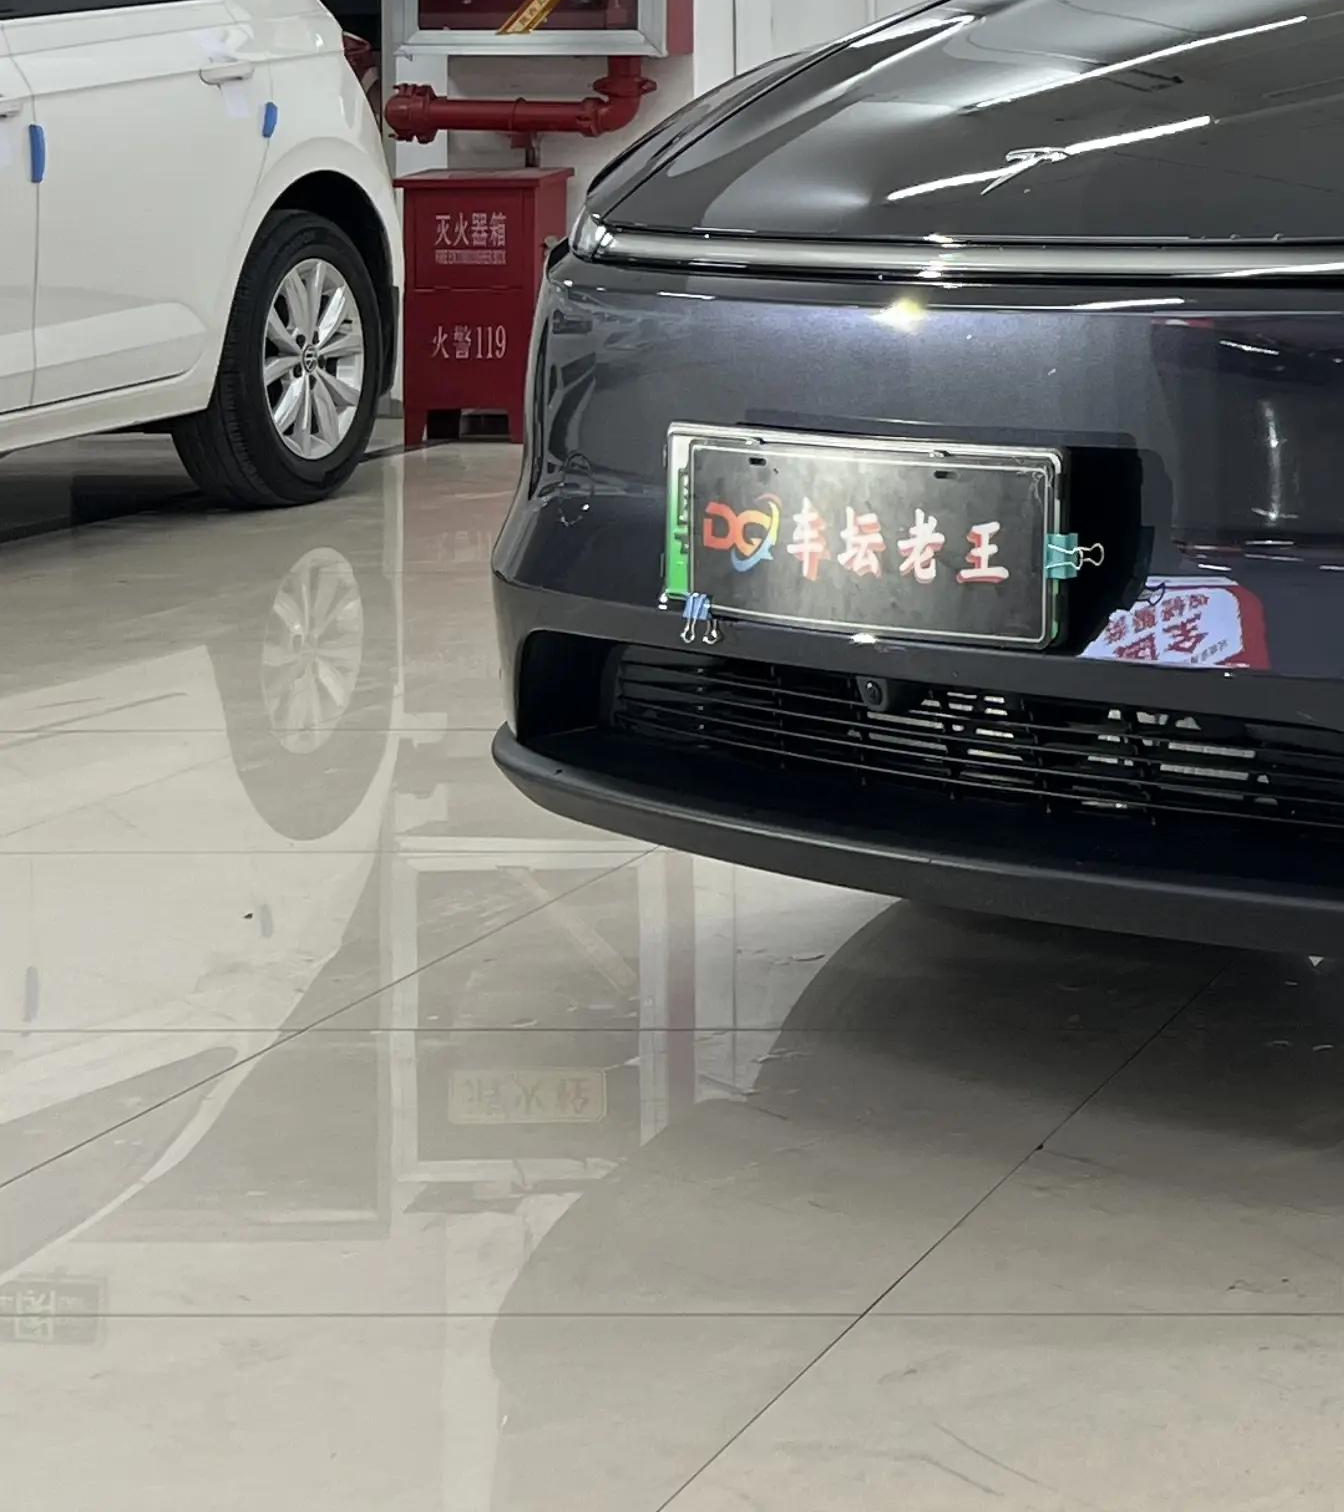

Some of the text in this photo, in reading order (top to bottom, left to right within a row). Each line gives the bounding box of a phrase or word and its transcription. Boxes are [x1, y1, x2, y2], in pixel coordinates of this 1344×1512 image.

[435, 212, 507, 247] 灭火器箱
[432, 325, 507, 359] 火警119
[786, 496, 1009, 585] 车坛老王
